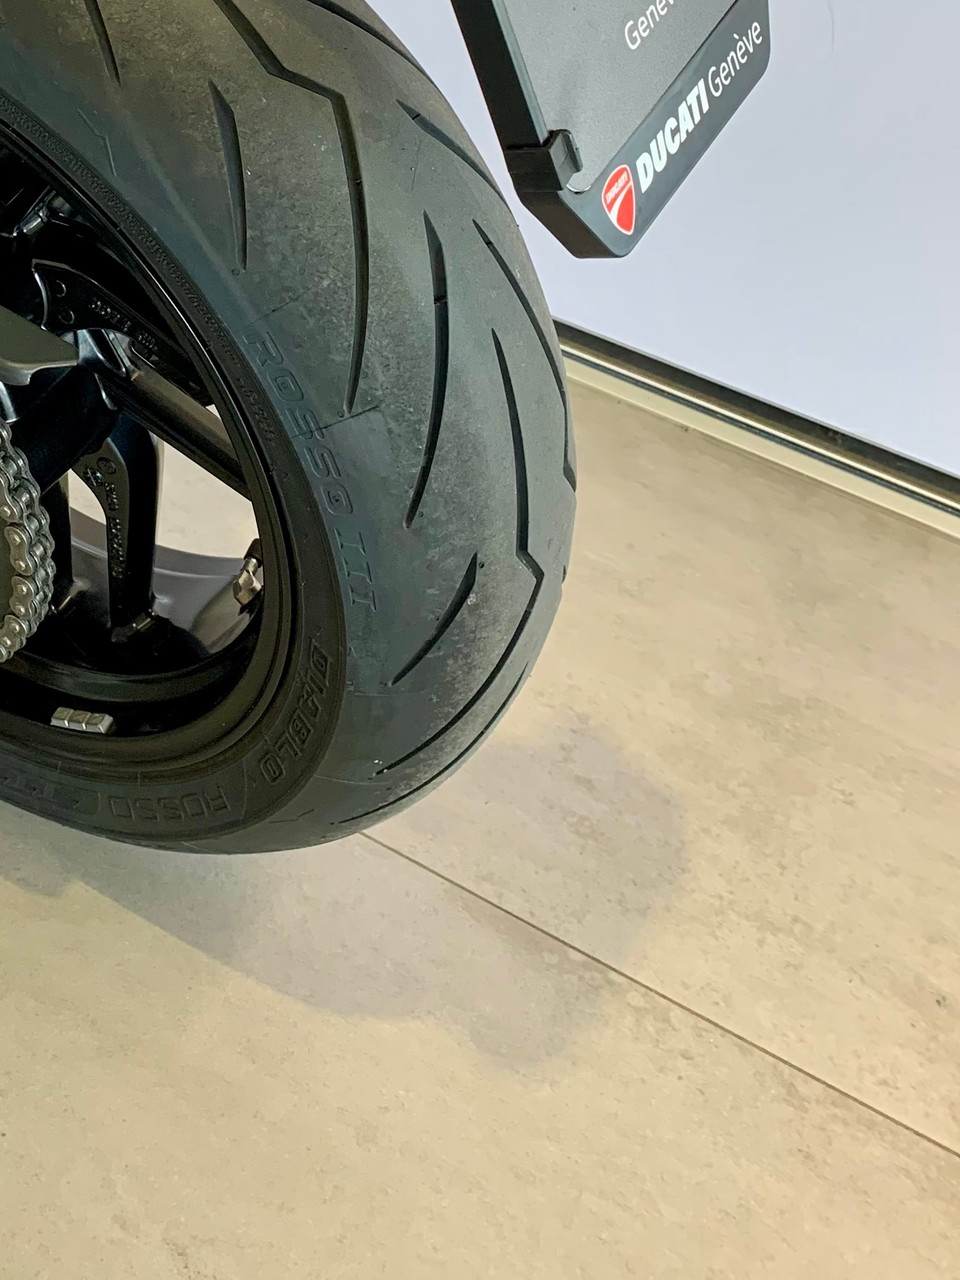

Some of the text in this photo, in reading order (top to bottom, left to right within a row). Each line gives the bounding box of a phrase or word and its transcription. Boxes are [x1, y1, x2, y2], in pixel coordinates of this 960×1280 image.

[635, 21, 763, 194] DUCATI Genève
[243, 331, 353, 516] ROSSO
[259, 638, 330, 784] DIABLO
[109, 784, 232, 821] ROSSO
